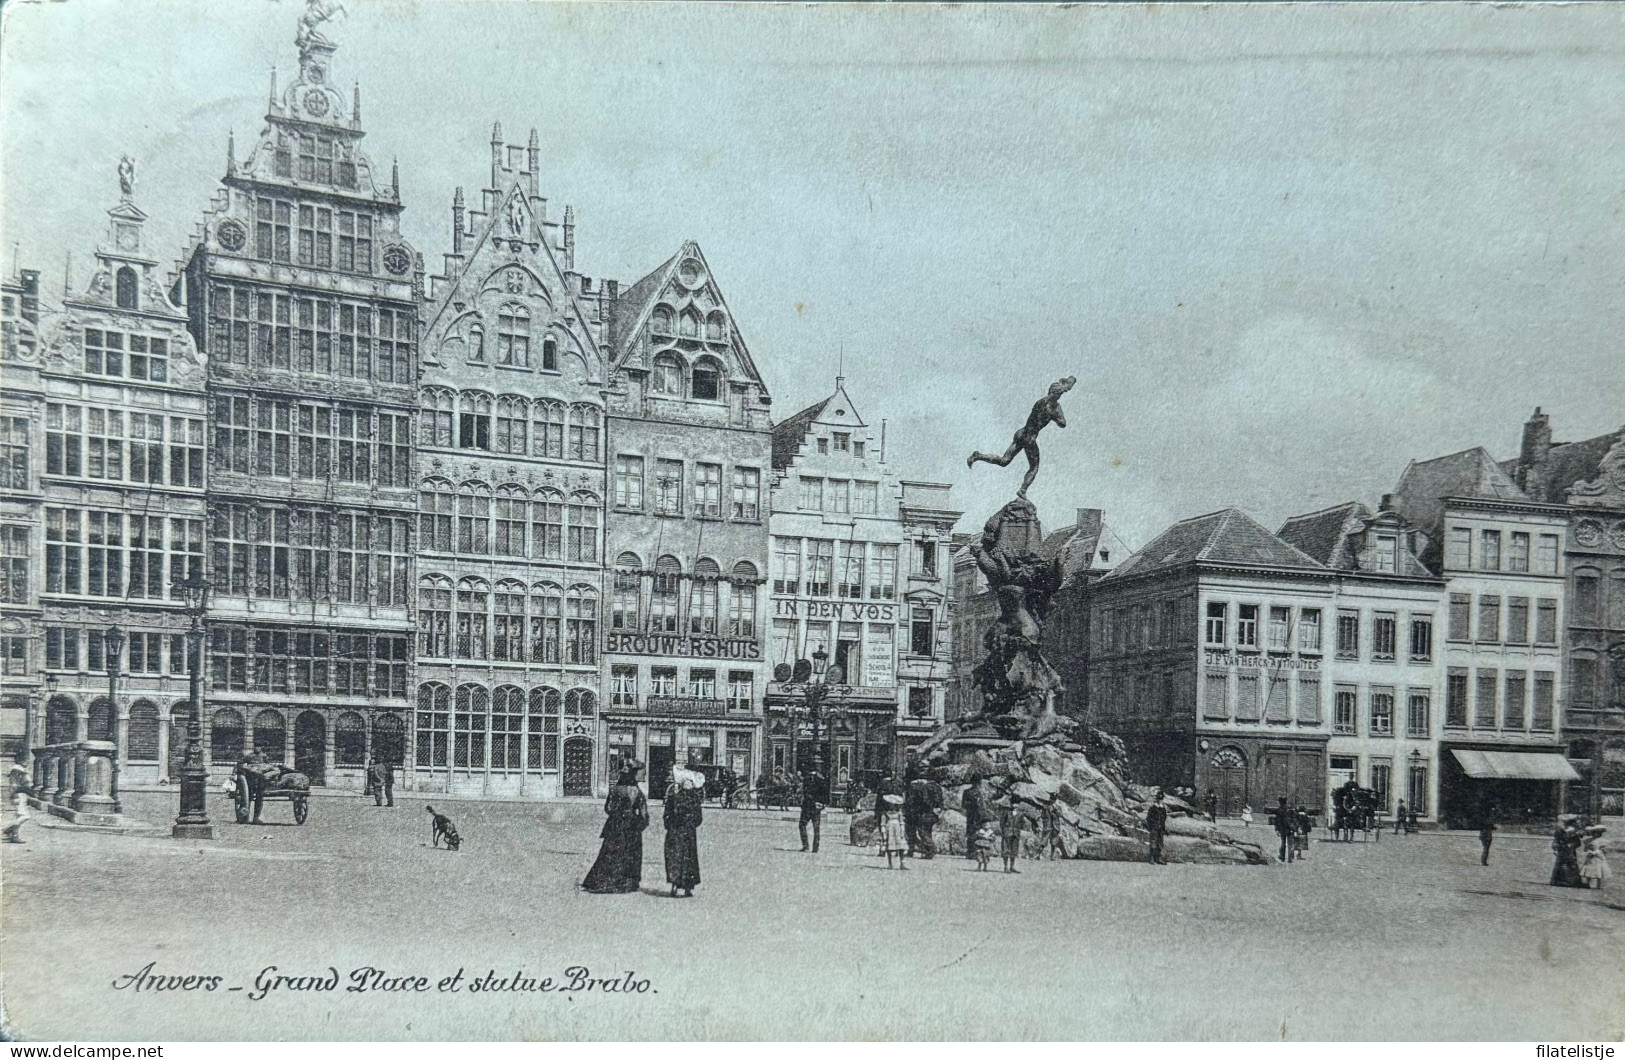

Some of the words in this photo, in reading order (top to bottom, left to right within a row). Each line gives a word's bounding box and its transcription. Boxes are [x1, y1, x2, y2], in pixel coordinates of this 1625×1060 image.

[776, 600, 798, 615] IN
[807, 601, 844, 618] DEN
[852, 603, 894, 620] VOS
[606, 634, 761, 659] BROUWERSHUIS
